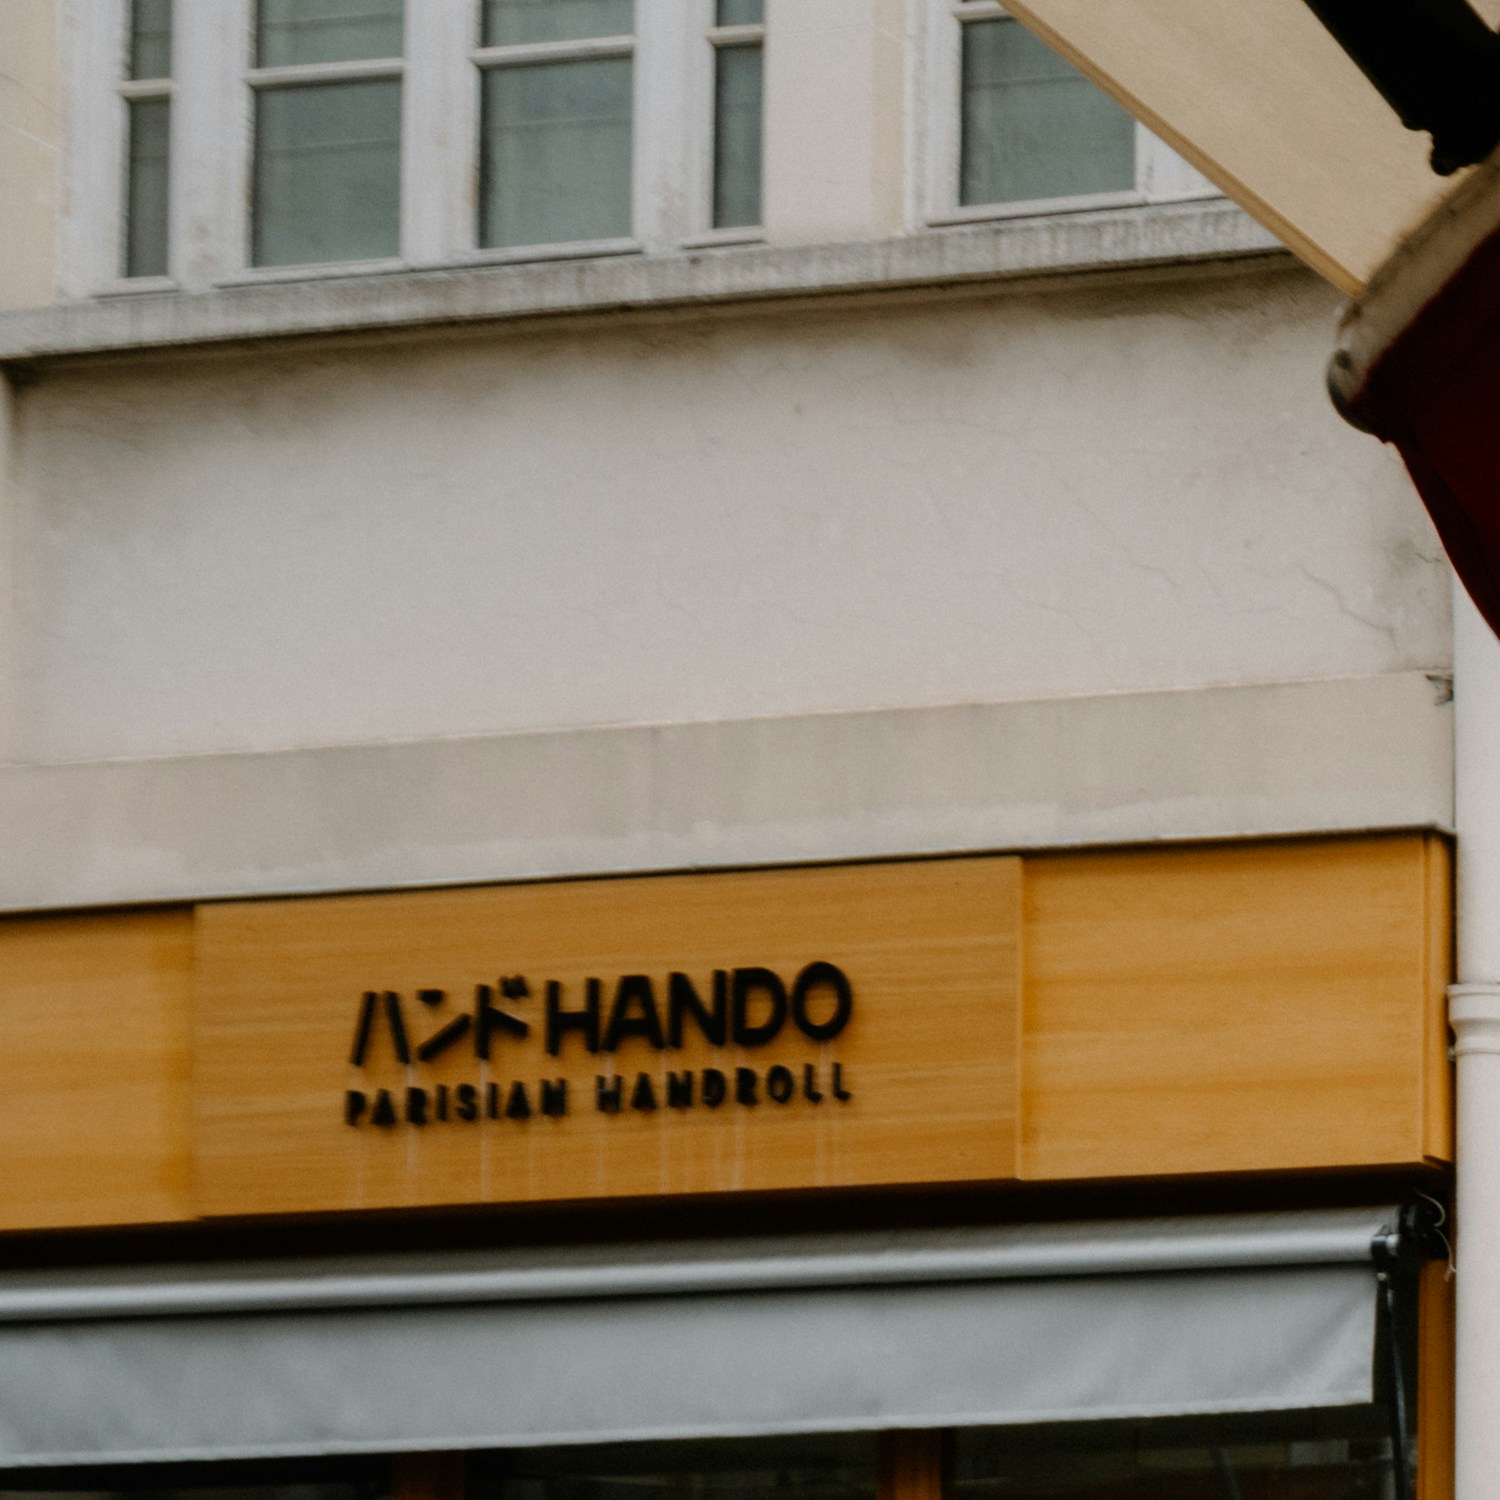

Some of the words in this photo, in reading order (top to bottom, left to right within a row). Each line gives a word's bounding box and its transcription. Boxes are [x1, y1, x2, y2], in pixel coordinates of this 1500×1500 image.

[543, 960, 853, 1056] HANDO
[344, 1077, 568, 1127] PARISIAN
[594, 1062, 854, 1115] HANDROLL
